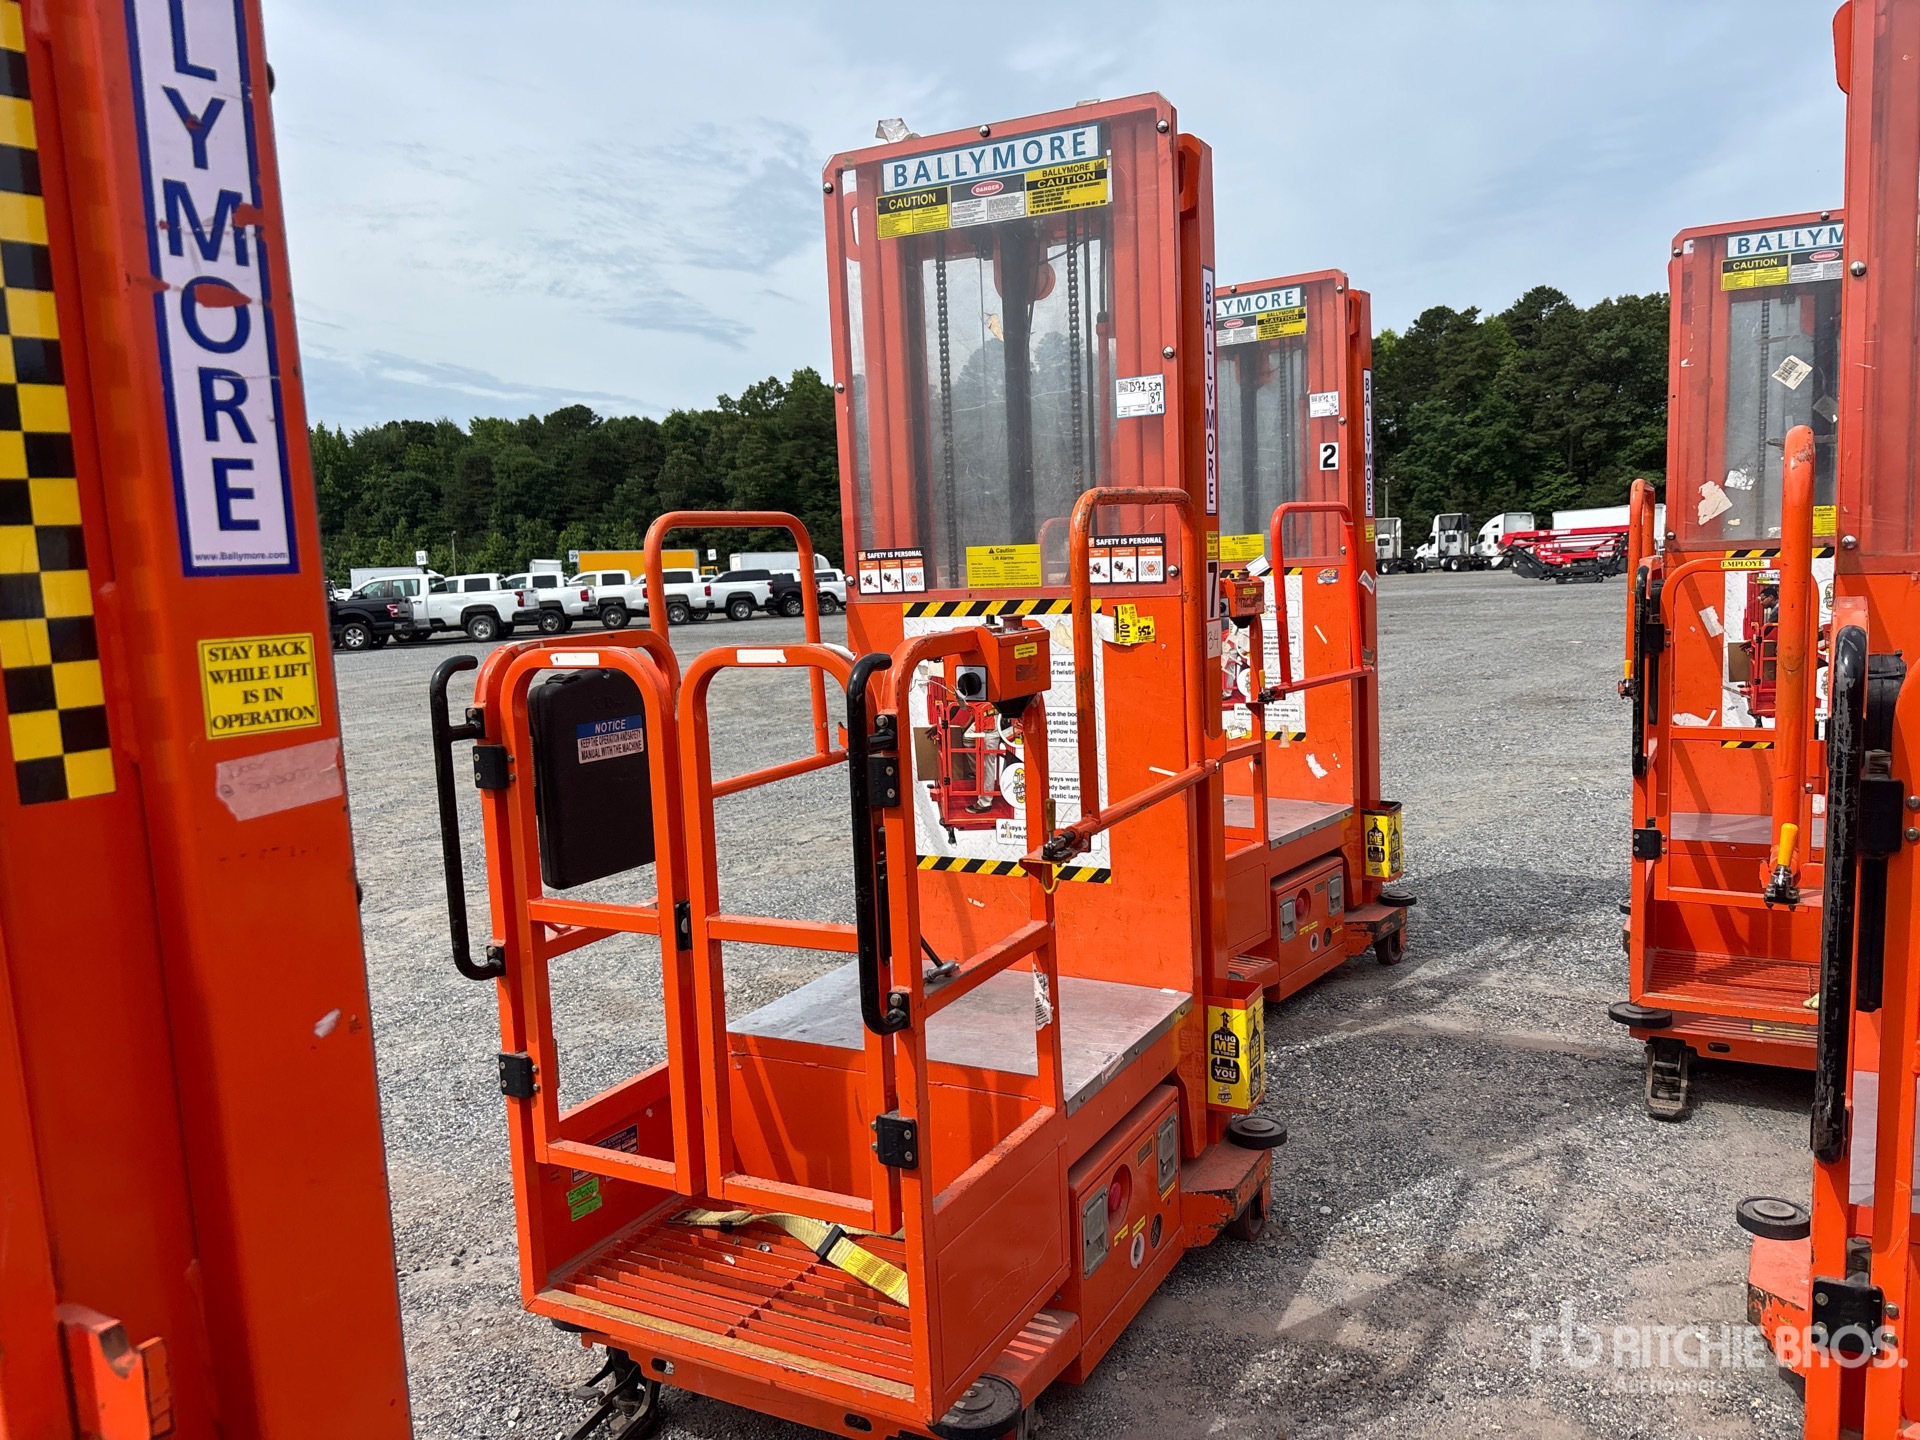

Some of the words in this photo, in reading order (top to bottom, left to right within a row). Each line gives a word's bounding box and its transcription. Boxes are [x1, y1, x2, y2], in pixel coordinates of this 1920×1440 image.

[893, 130, 1087, 187] BALLYMORE
[1042, 162, 1090, 178] BALLYMORE
[1037, 171, 1096, 188] CAUTION
[975, 184, 1000, 193] DANGER
[888, 192, 936, 210] CAUTION
[1732, 258, 1778, 270] CAUTION
[1263, 314, 1299, 325] CAUTION
[1266, 308, 1295, 318] BALLYMORE
[1204, 281, 1215, 504] BALLYMORE
[1364, 377, 1373, 511] BALLYMORE
[1322, 444, 1337, 468] 2
[1096, 538, 1119, 546] SAFETY
[1129, 536, 1163, 545] PERSONAL
[195, 551, 288, 562] www.Ballymore.com
[867, 551, 887, 559] SAFETY
[1207, 561, 1218, 618] 7
[208, 644, 254, 662] STAY
[257, 640, 309, 659] BACK
[208, 665, 271, 685] WHILE
[274, 661, 311, 679] LIFT
[242, 688, 259, 705] IS
[262, 686, 284, 703] IN
[212, 704, 317, 730] OPERATION
[594, 719, 627, 734] NOTICE
[1050, 728, 1069, 736] yellow
[581, 738, 591, 748] KEEP
[591, 736, 599, 747] THE
[599, 733, 620, 746] OPERATION
[581, 748, 601, 761] MANUAL
[601, 746, 613, 757] WITH
[613, 744, 622, 754] THE
[622, 740, 642, 753] MACHINE
[1213, 1033, 1236, 1042] PLUG
[1214, 1040, 1236, 1053] ME
[1214, 1068, 1237, 1079] YOU
